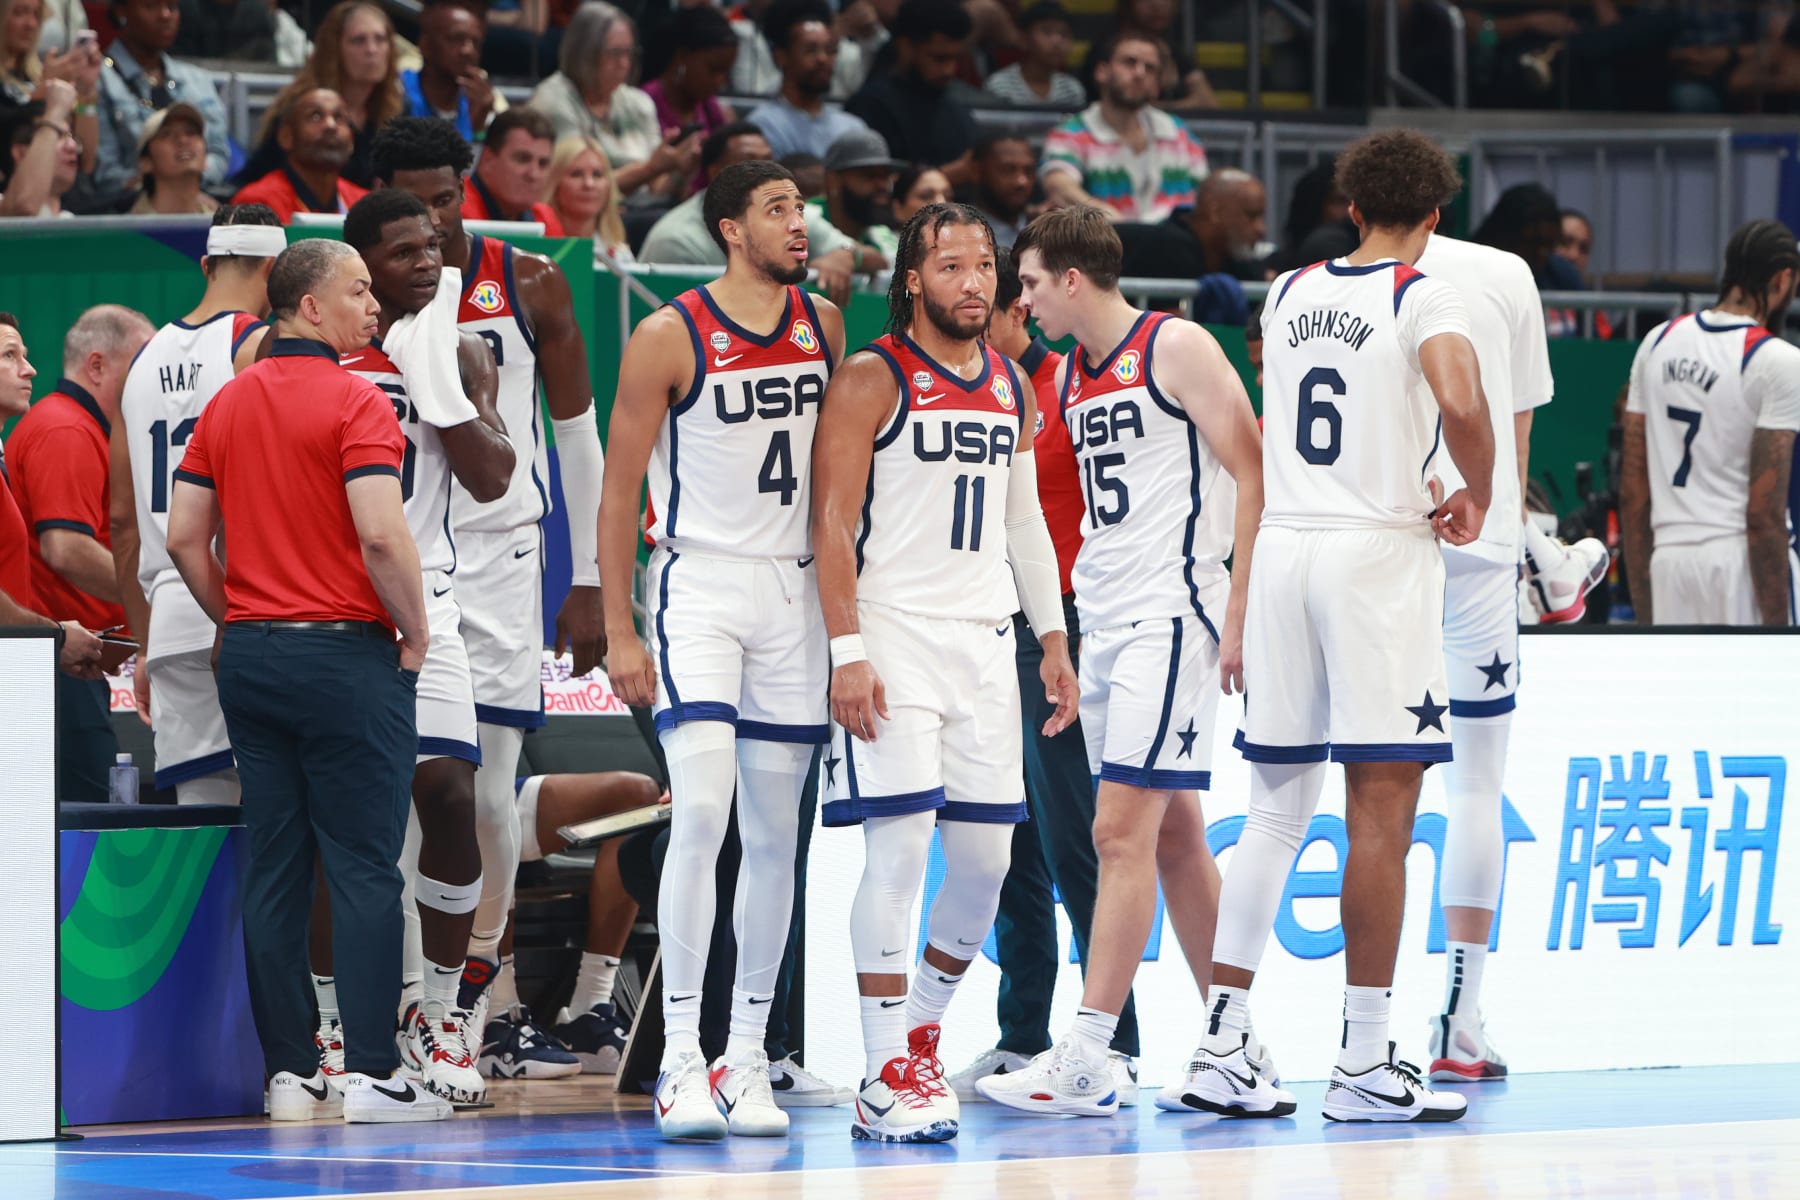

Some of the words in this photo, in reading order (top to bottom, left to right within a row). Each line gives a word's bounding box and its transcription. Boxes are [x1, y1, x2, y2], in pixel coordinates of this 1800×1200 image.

[1288, 310, 1374, 351] JOHNSON
[159, 363, 203, 393] HART
[714, 373, 824, 424] USA
[913, 421, 1015, 468] USA
[1070, 400, 1145, 452] USA
[1296, 367, 1346, 465] 6
[1667, 404, 1702, 487] 7
[758, 430, 798, 506] 4
[1085, 452, 1130, 529] 15
[950, 474, 985, 552] 11
[1547, 750, 1787, 950] 腾讯
[275, 1077, 293, 1086] NIKE
